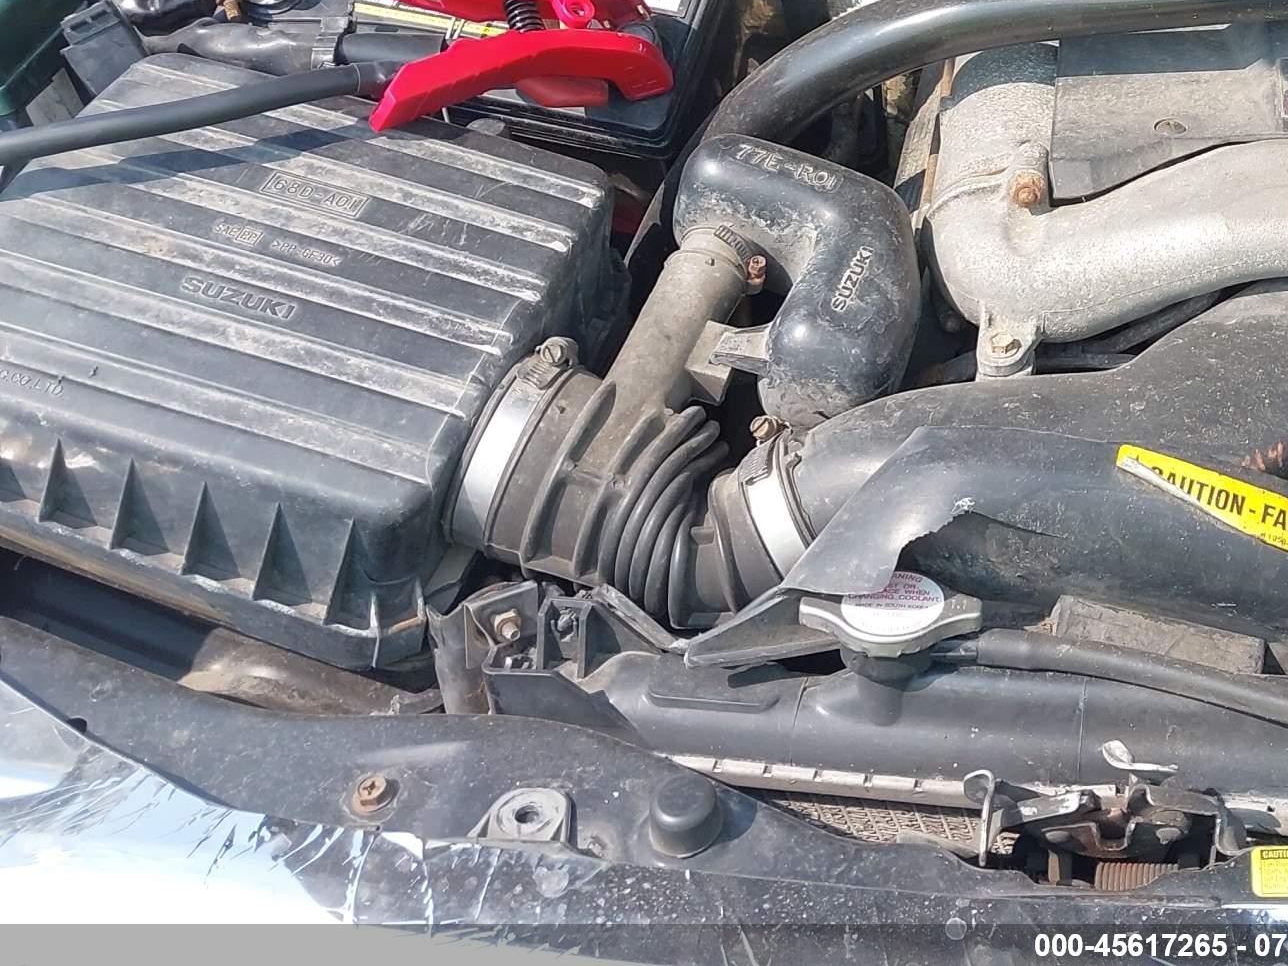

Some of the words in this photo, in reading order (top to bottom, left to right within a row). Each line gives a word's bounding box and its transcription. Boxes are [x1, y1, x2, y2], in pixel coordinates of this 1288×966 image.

[272, 179, 361, 212] 68D-A01
[181, 275, 297, 321] SUZUKI
[831, 245, 875, 313] SUZUKI
